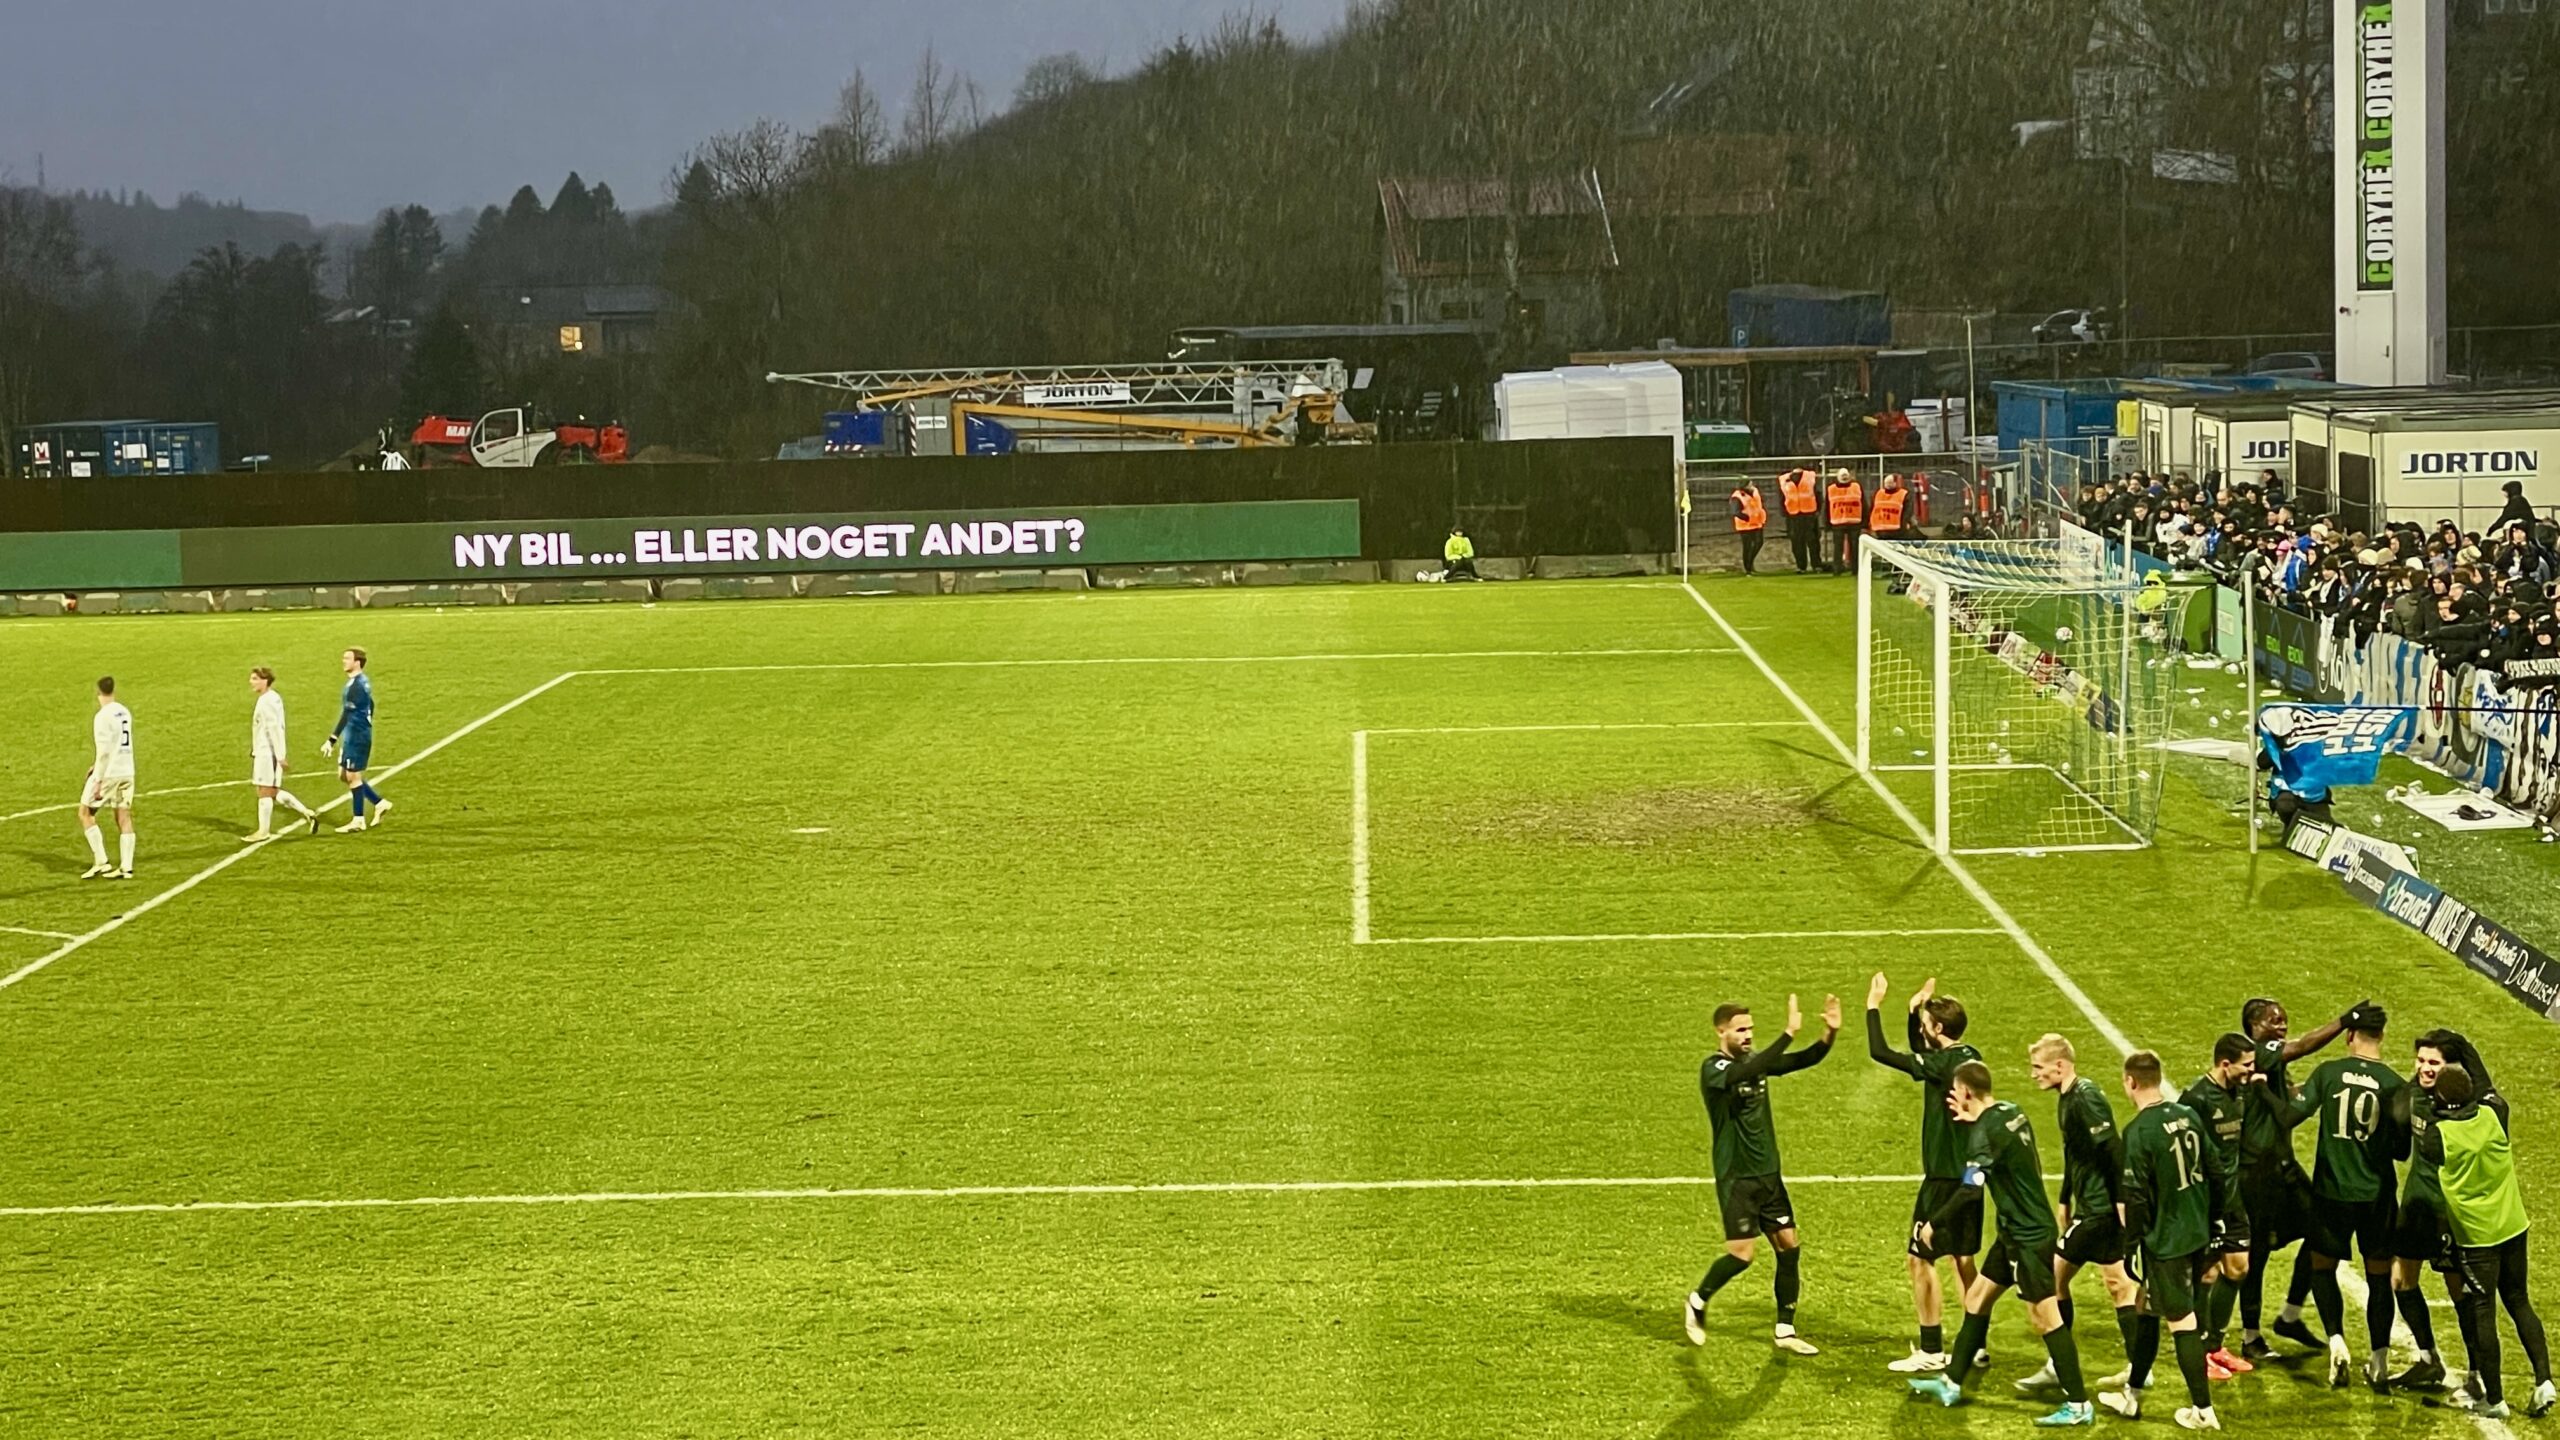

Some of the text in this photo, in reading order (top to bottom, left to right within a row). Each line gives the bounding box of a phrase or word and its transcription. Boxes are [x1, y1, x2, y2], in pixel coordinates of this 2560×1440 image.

[2365, 3, 2393, 140] CORYHEX
[2365, 147, 2393, 283] CORYHEX
[1041, 384, 1113, 398] JORTON
[2402, 449, 2538, 474] JORTON
[454, 533, 513, 567] NY
[519, 532, 584, 565] BIL
[634, 528, 760, 563] ELLER
[766, 524, 916, 560] NOGET
[920, 518, 1086, 556] ANDET?
[2387, 879, 2433, 929] bravida
[2504, 948, 2560, 1006] Dohuset
[2332, 1087, 2380, 1142] 19
[2169, 1130, 2204, 1191] 12
